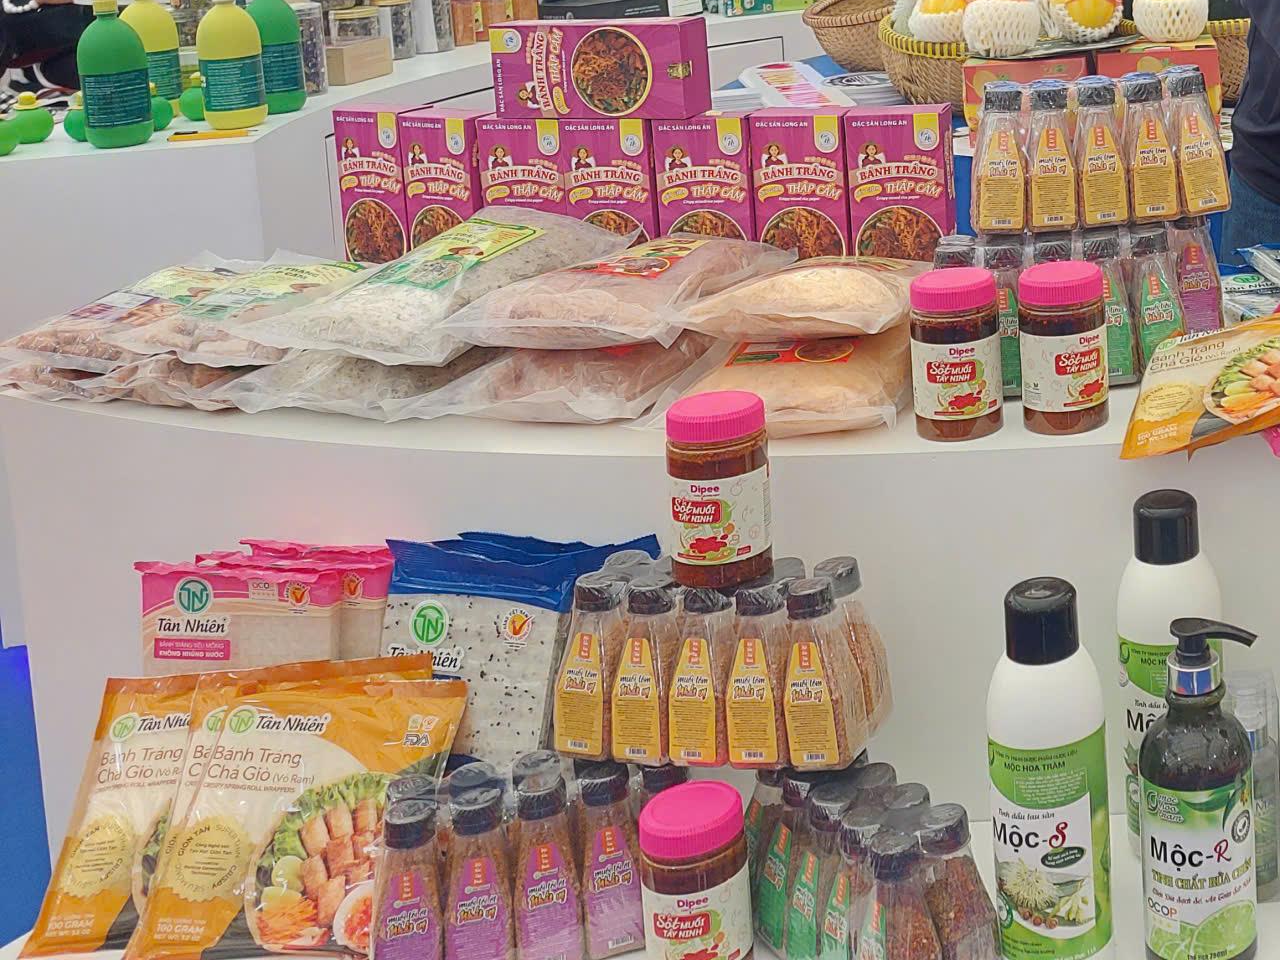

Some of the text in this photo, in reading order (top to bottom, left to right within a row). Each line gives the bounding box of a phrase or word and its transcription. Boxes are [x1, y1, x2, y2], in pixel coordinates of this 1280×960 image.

[949, 347, 976, 358] Dipee
[929, 361, 952, 374] Sốt
[690, 485, 720, 495] Dipee
[678, 513, 713, 523] TÂY NINH
[158, 618, 226, 633] Tân Nhiên
[256, 716, 281, 730] Tân
[282, 717, 325, 733] Nhiên
[213, 745, 302, 767] Bánh Tráng
[125, 765, 153, 780] Giò
[208, 763, 239, 781] Chả
[243, 764, 270, 783] Giò
[1004, 761, 1021, 773] MỘC
[1022, 762, 1040, 772] HOA
[1151, 836, 1231, 872] Mộc-R
[1175, 873, 1206, 889] CHẤT
[1147, 897, 1177, 918] OCOP
[175, 924, 205, 934] GRAM
[662, 927, 703, 938] TÂY NINH
